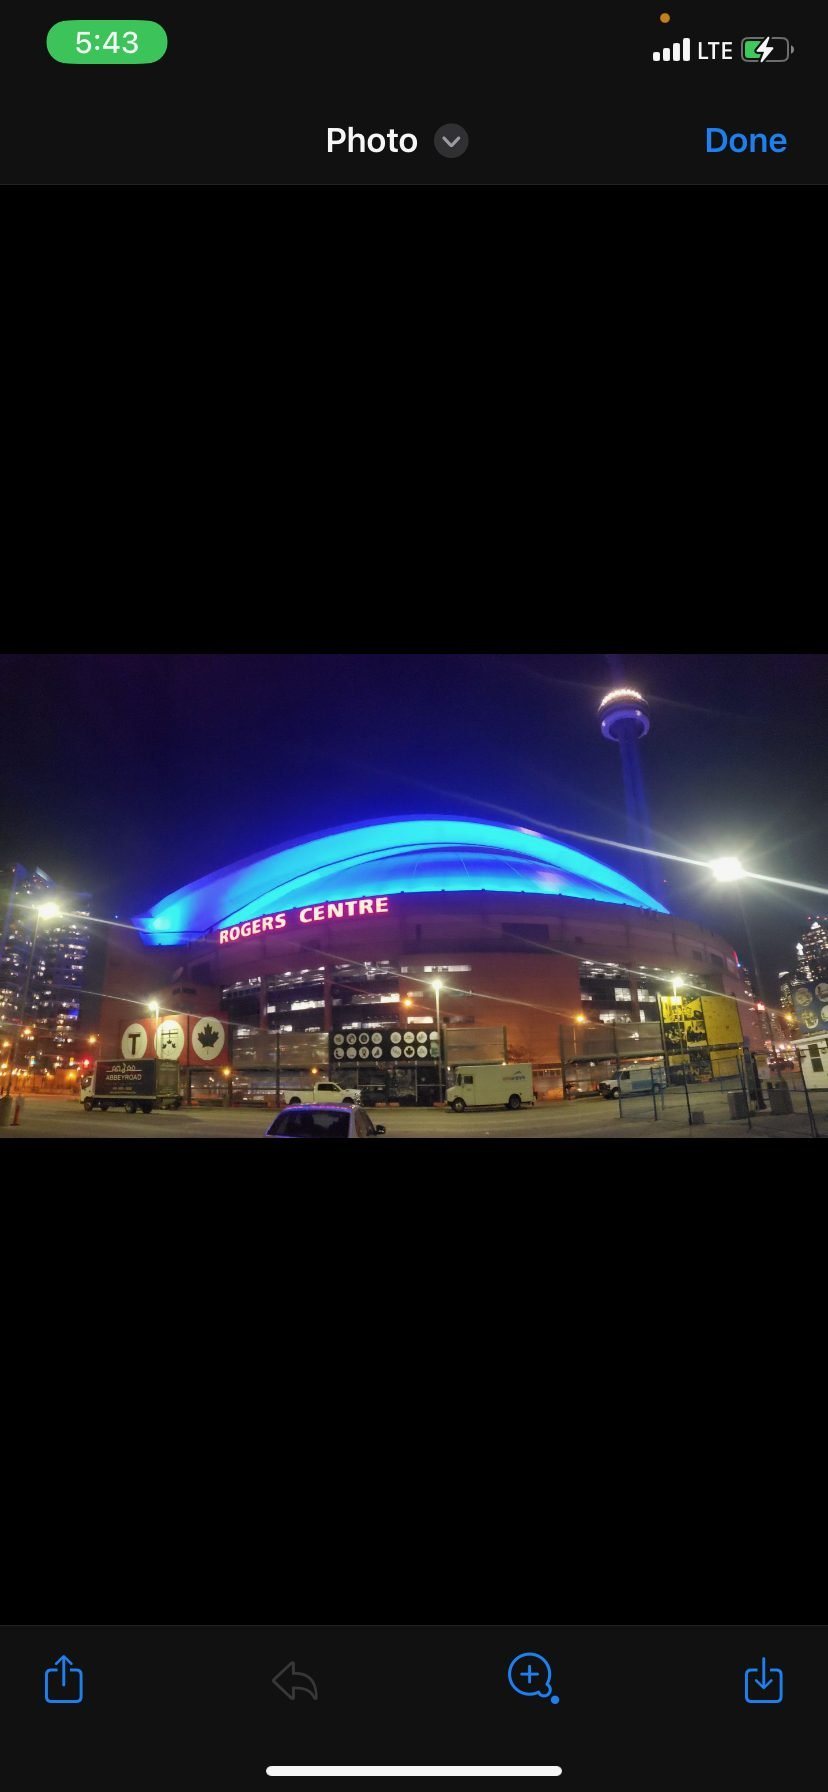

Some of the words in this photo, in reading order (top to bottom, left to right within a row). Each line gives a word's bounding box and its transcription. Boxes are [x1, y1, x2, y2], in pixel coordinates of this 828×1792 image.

[219, 913, 286, 944] ROGERS
[299, 897, 389, 923] CENTRE
[128, 1032, 141, 1056] T
